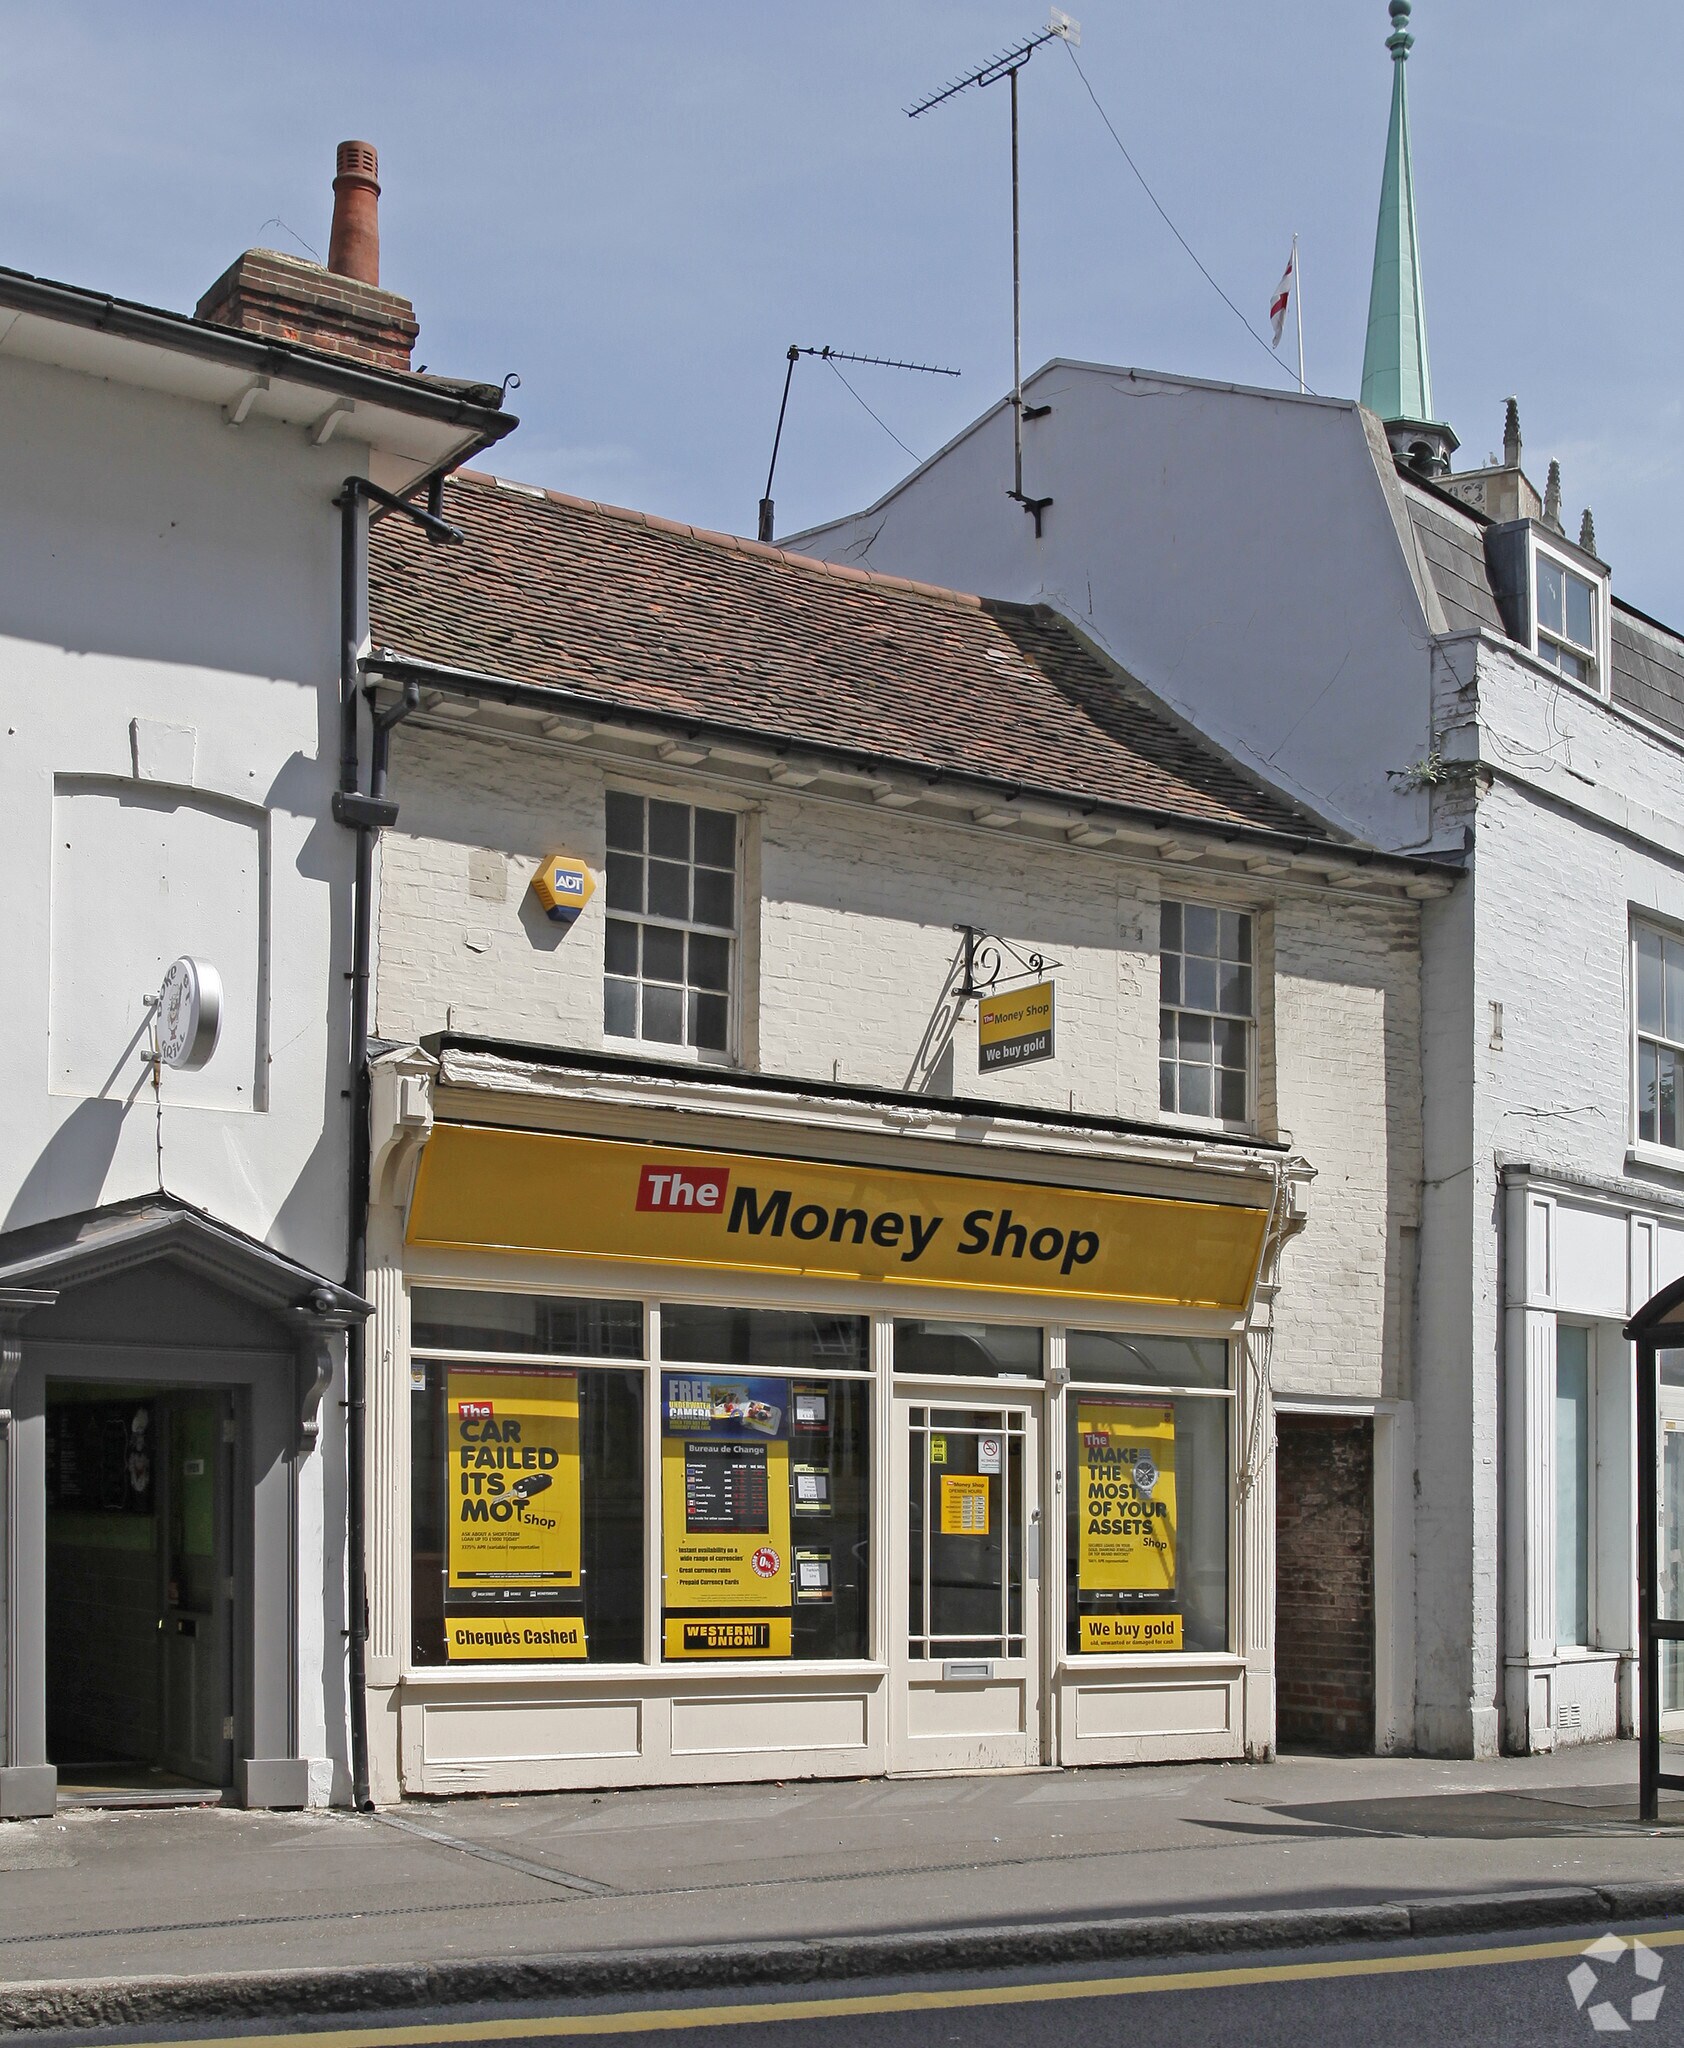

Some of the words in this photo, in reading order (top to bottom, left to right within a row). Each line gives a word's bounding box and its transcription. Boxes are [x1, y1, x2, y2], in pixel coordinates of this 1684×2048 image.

[556, 876, 583, 890] ADT
[983, 1015, 994, 1024] The
[994, 1010, 1023, 1024] Money
[1026, 1003, 1049, 1017] Shop
[986, 1049, 1000, 1061] We
[1003, 1044, 1021, 1058] buy
[1023, 1036, 1045, 1056] gold
[648, 1174, 719, 1207] The
[727, 1186, 944, 1262] Money
[957, 1209, 1100, 1275] Shop
[669, 1380, 712, 1401] FREE
[460, 1404, 490, 1417] The
[669, 1401, 710, 1409] UNDERWATER
[670, 1408, 711, 1420] CAMERA
[460, 1420, 521, 1443] CAR
[1085, 1434, 1107, 1445] The
[461, 1446, 559, 1470] FAILED
[733, 1446, 764, 1455] Change
[1088, 1448, 1138, 1463] MAKE
[1088, 1465, 1121, 1481] THE
[461, 1472, 505, 1495] ITS
[1088, 1483, 1138, 1499] MOST
[461, 1499, 530, 1522] MOT
[1088, 1501, 1112, 1516] OF
[1117, 1502, 1166, 1518] YOUR
[524, 1514, 556, 1529] Shop
[1088, 1519, 1153, 1535] ASSETS
[1143, 1538, 1167, 1551] Shop
[456, 1630, 520, 1646] Cheques
[524, 1629, 577, 1644] Cashed
[687, 1626, 753, 1636] WESTERN
[1089, 1623, 1110, 1636] We
[1115, 1622, 1139, 1639] buy
[1144, 1621, 1174, 1638] gold
[708, 1636, 753, 1646] UNION
